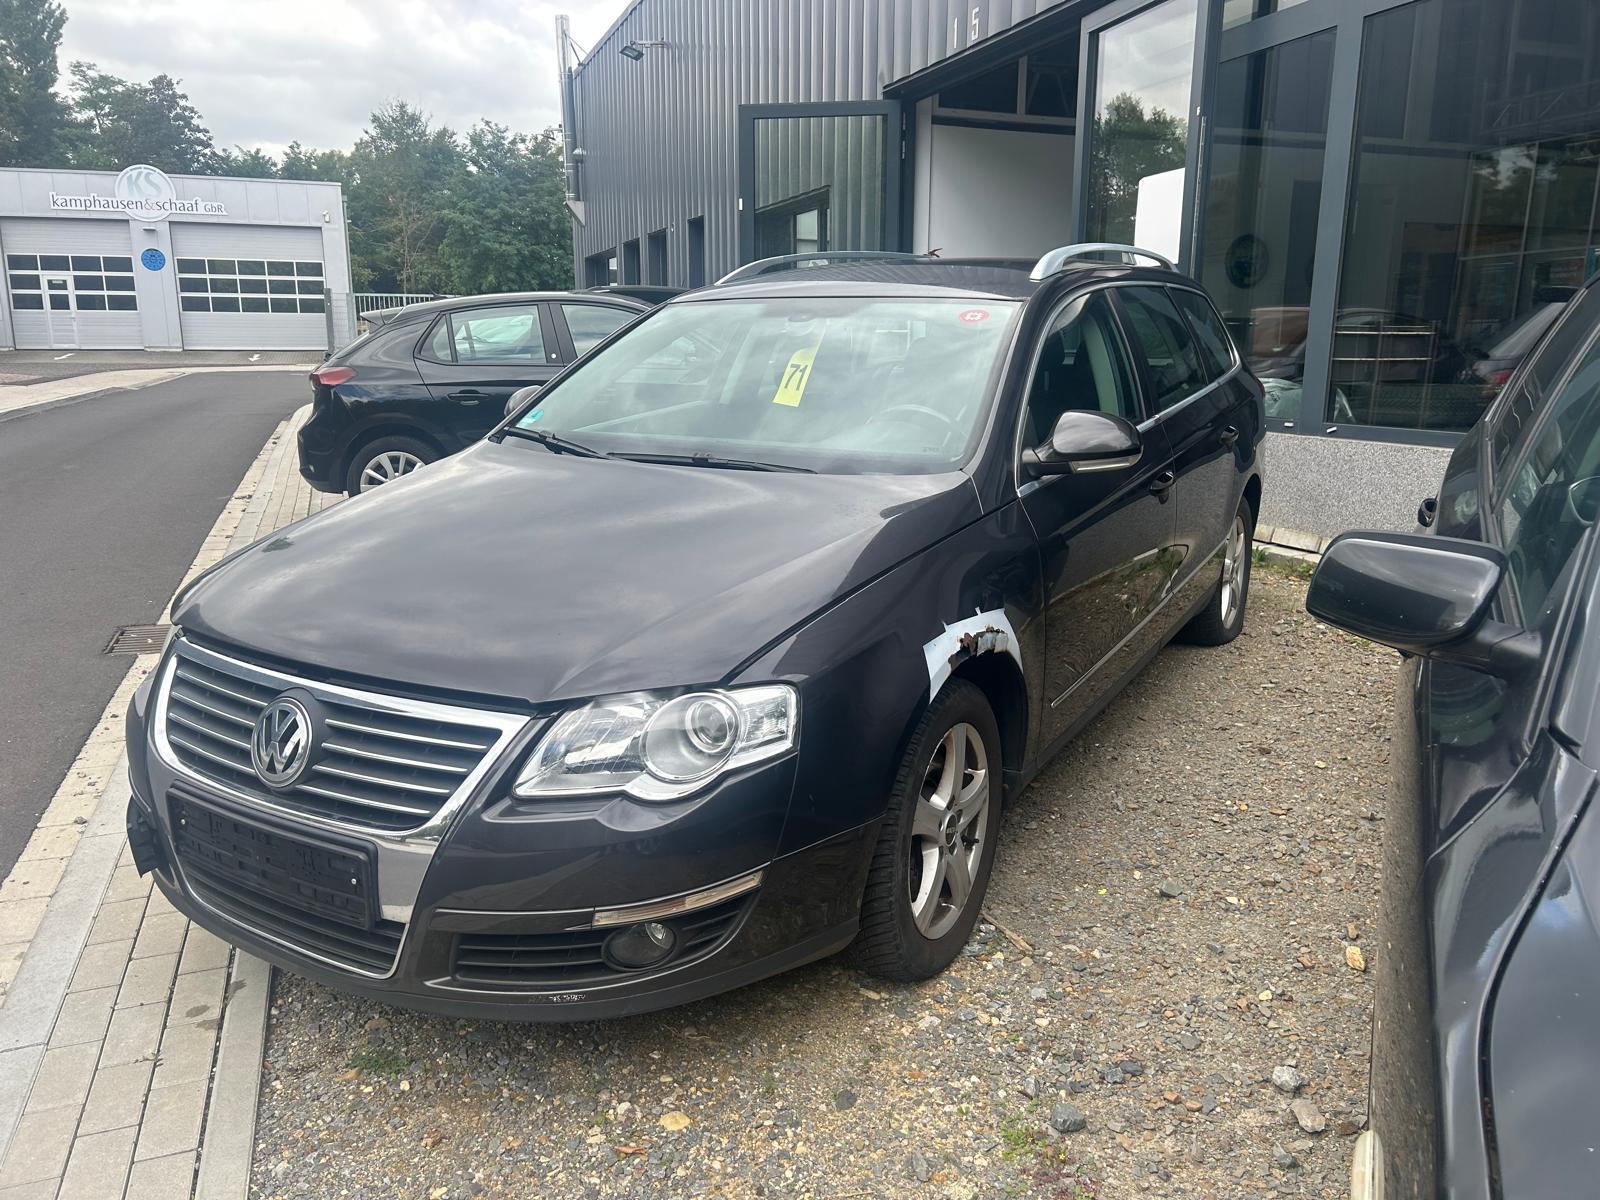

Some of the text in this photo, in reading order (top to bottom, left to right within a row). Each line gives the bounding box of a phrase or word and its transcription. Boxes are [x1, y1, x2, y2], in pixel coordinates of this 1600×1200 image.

[953, 6, 980, 49] 15
[126, 169, 161, 197] KS
[203, 203, 224, 213] GbR
[784, 363, 808, 391] 71
